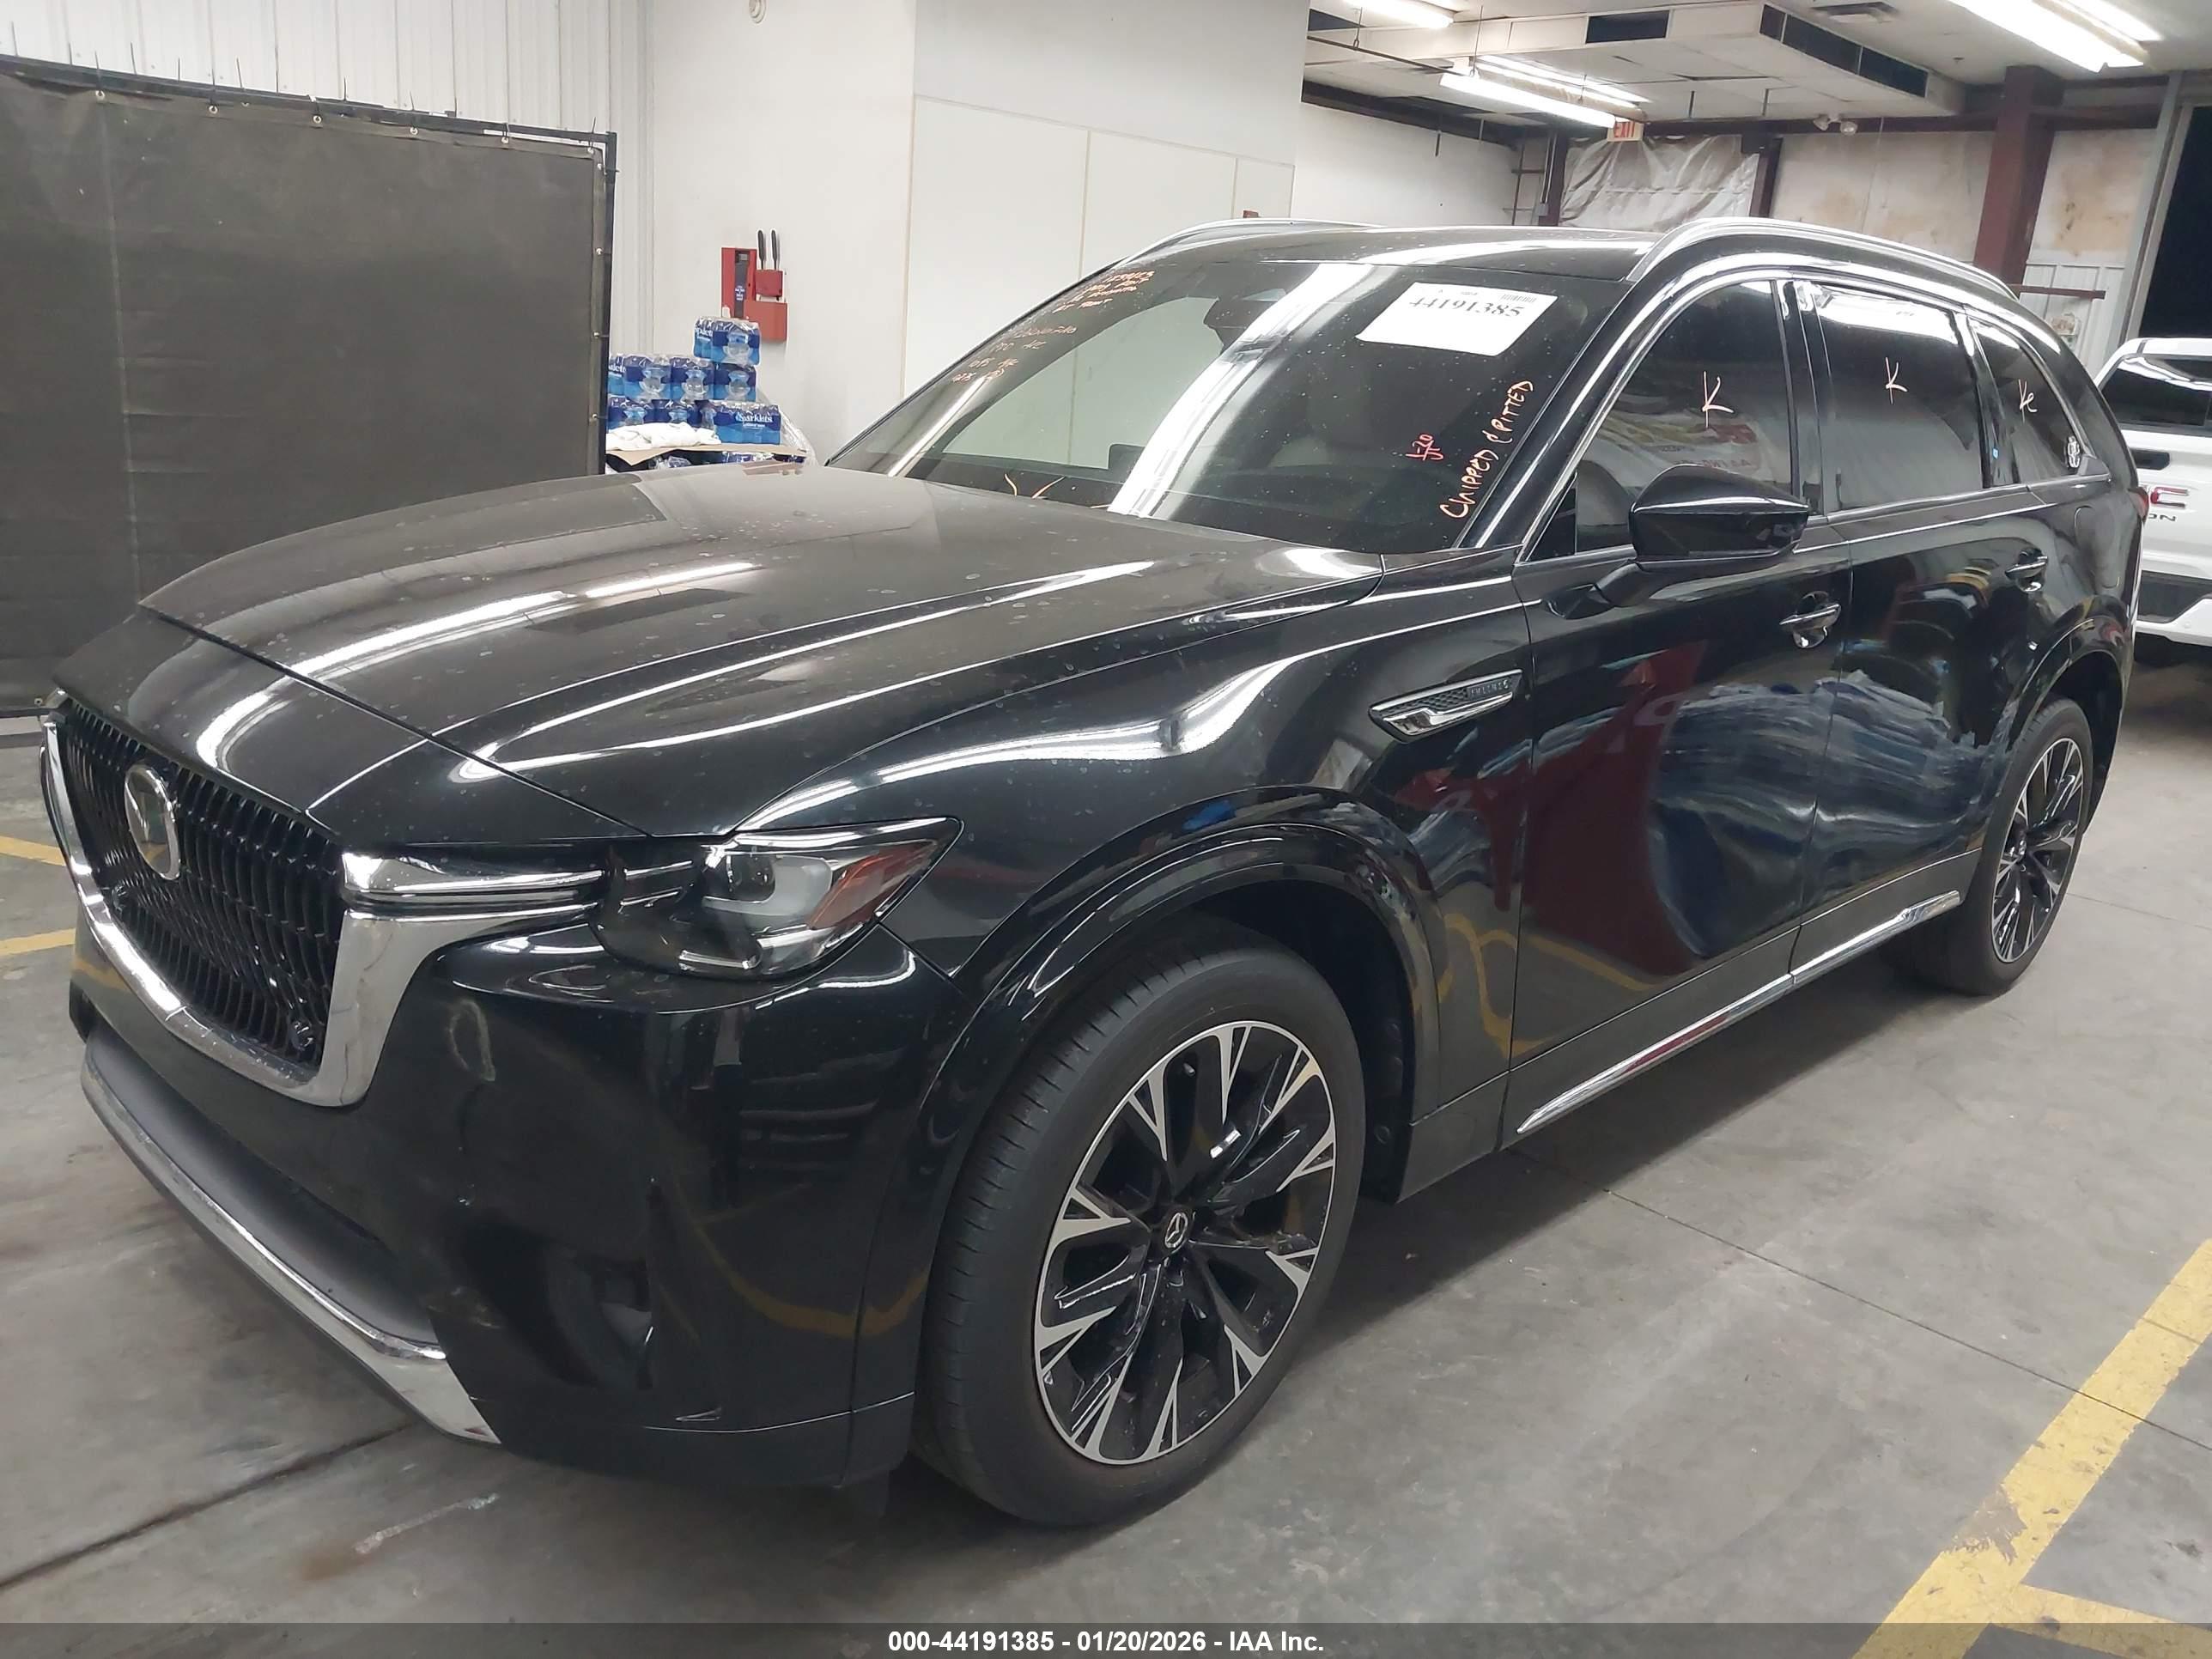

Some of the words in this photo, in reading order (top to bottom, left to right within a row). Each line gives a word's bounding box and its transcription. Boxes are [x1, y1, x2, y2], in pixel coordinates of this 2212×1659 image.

[1409, 297, 1525, 317] 44191385
[1490, 380, 1534, 432] PITTED
[1702, 370, 1735, 428] K
